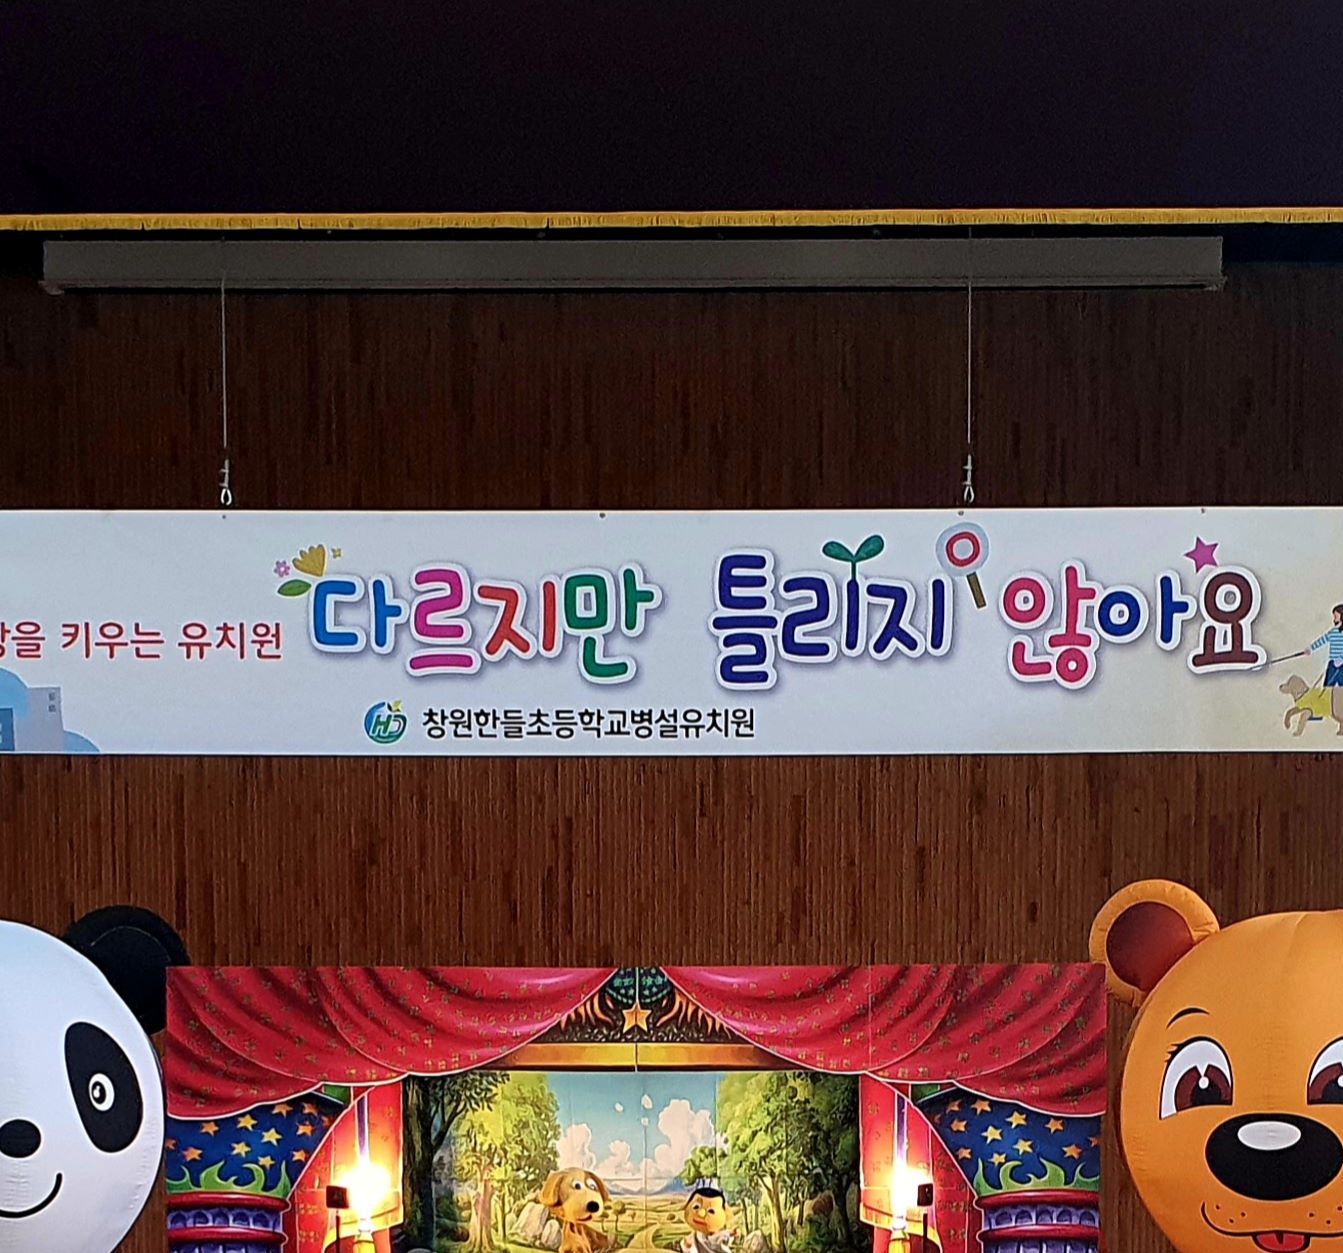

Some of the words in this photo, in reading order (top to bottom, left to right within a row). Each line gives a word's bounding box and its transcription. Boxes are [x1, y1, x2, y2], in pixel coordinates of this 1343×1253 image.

[312, 566, 657, 677] 다르지만
[713, 551, 945, 684] 틀리지
[1004, 567, 1261, 684] 않아요
[61, 621, 166, 659] 키우는
[178, 621, 283, 659] 유치원
[422, 707, 756, 739] 창원한들초등학교병설유치원
